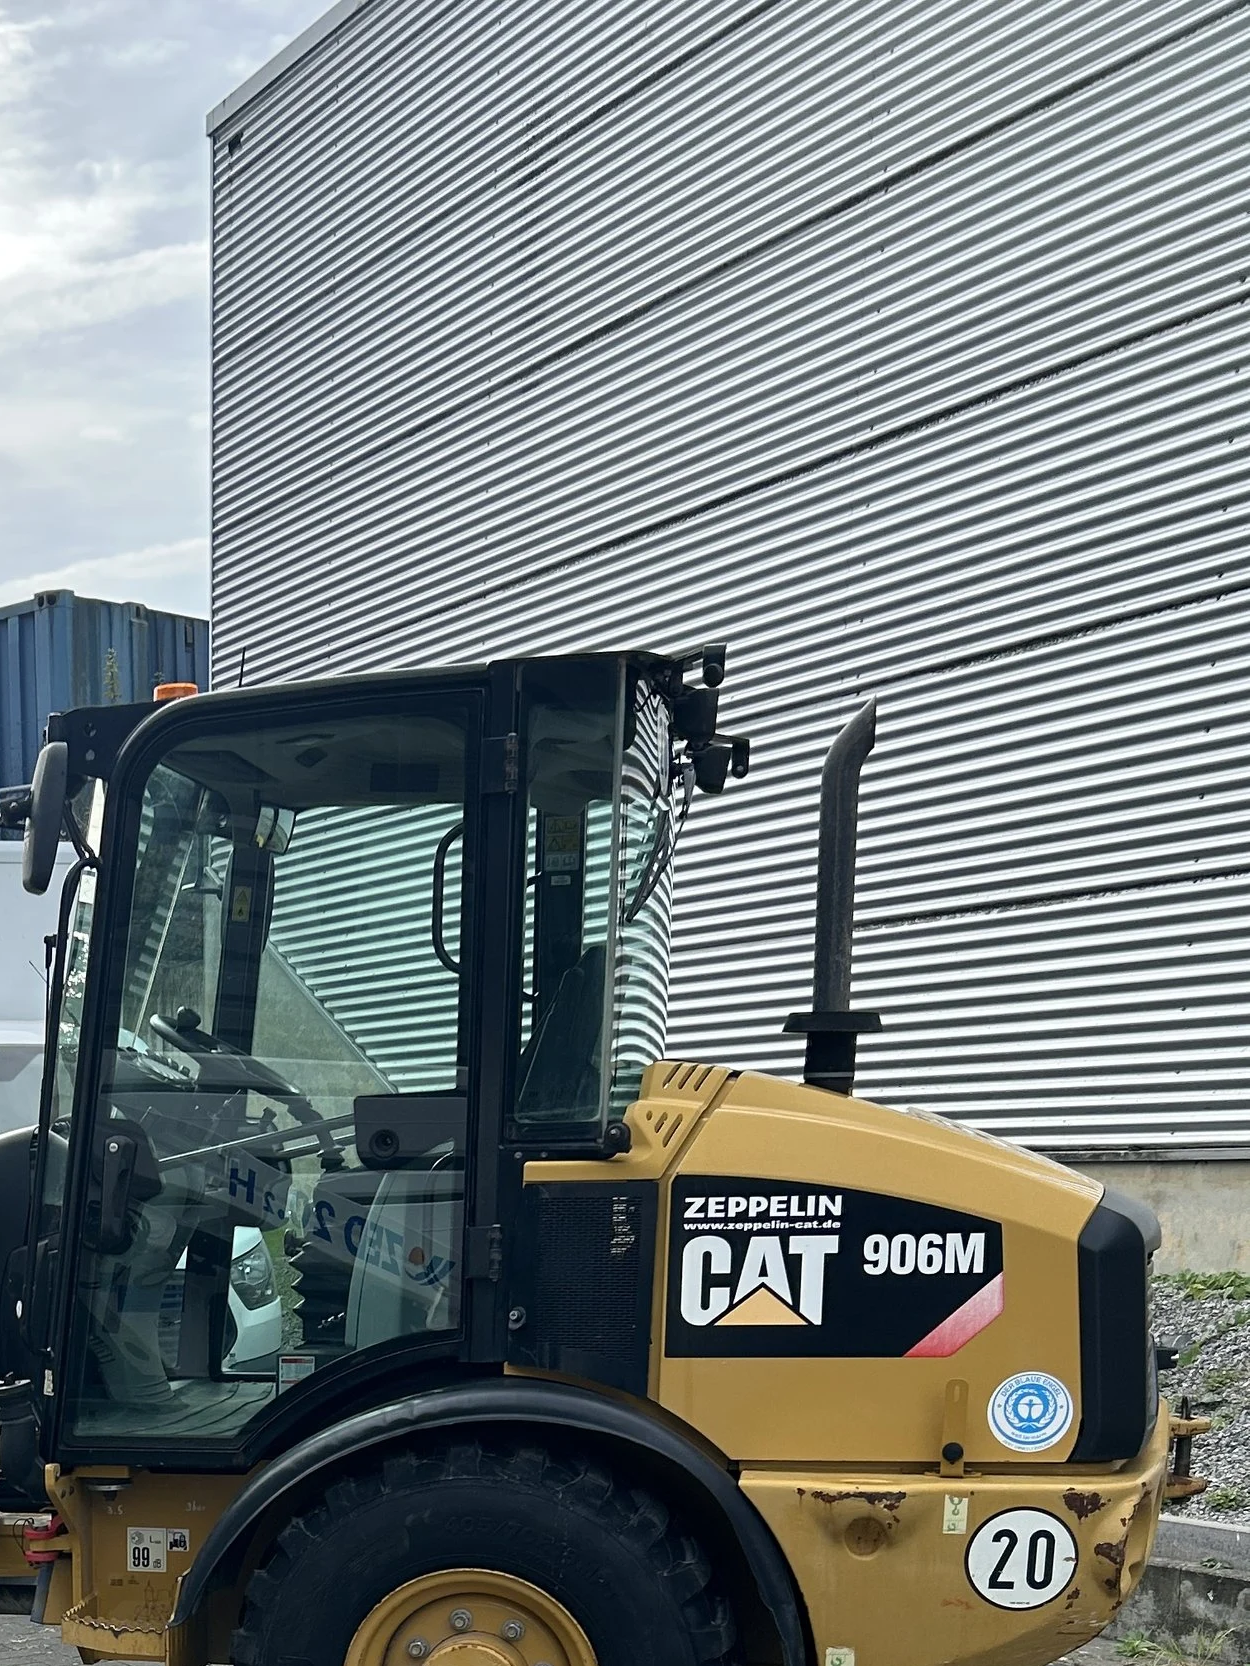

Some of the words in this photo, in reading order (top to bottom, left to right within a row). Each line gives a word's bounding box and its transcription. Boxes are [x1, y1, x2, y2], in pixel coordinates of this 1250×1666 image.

[683, 1195, 843, 1218] ZEPPELIN
[682, 1220, 841, 1232] www.zeppelin-cat.de
[862, 1232, 986, 1275] 906M
[680, 1235, 839, 1326] CAT
[1001, 1383, 1016, 1397] DER
[1015, 1375, 1042, 1386] BLAUE
[1042, 1377, 1062, 1397] ENGEL
[132, 1546, 150, 1568] 99
[153, 1558, 162, 1569] dB
[988, 1528, 1056, 1590] 20
